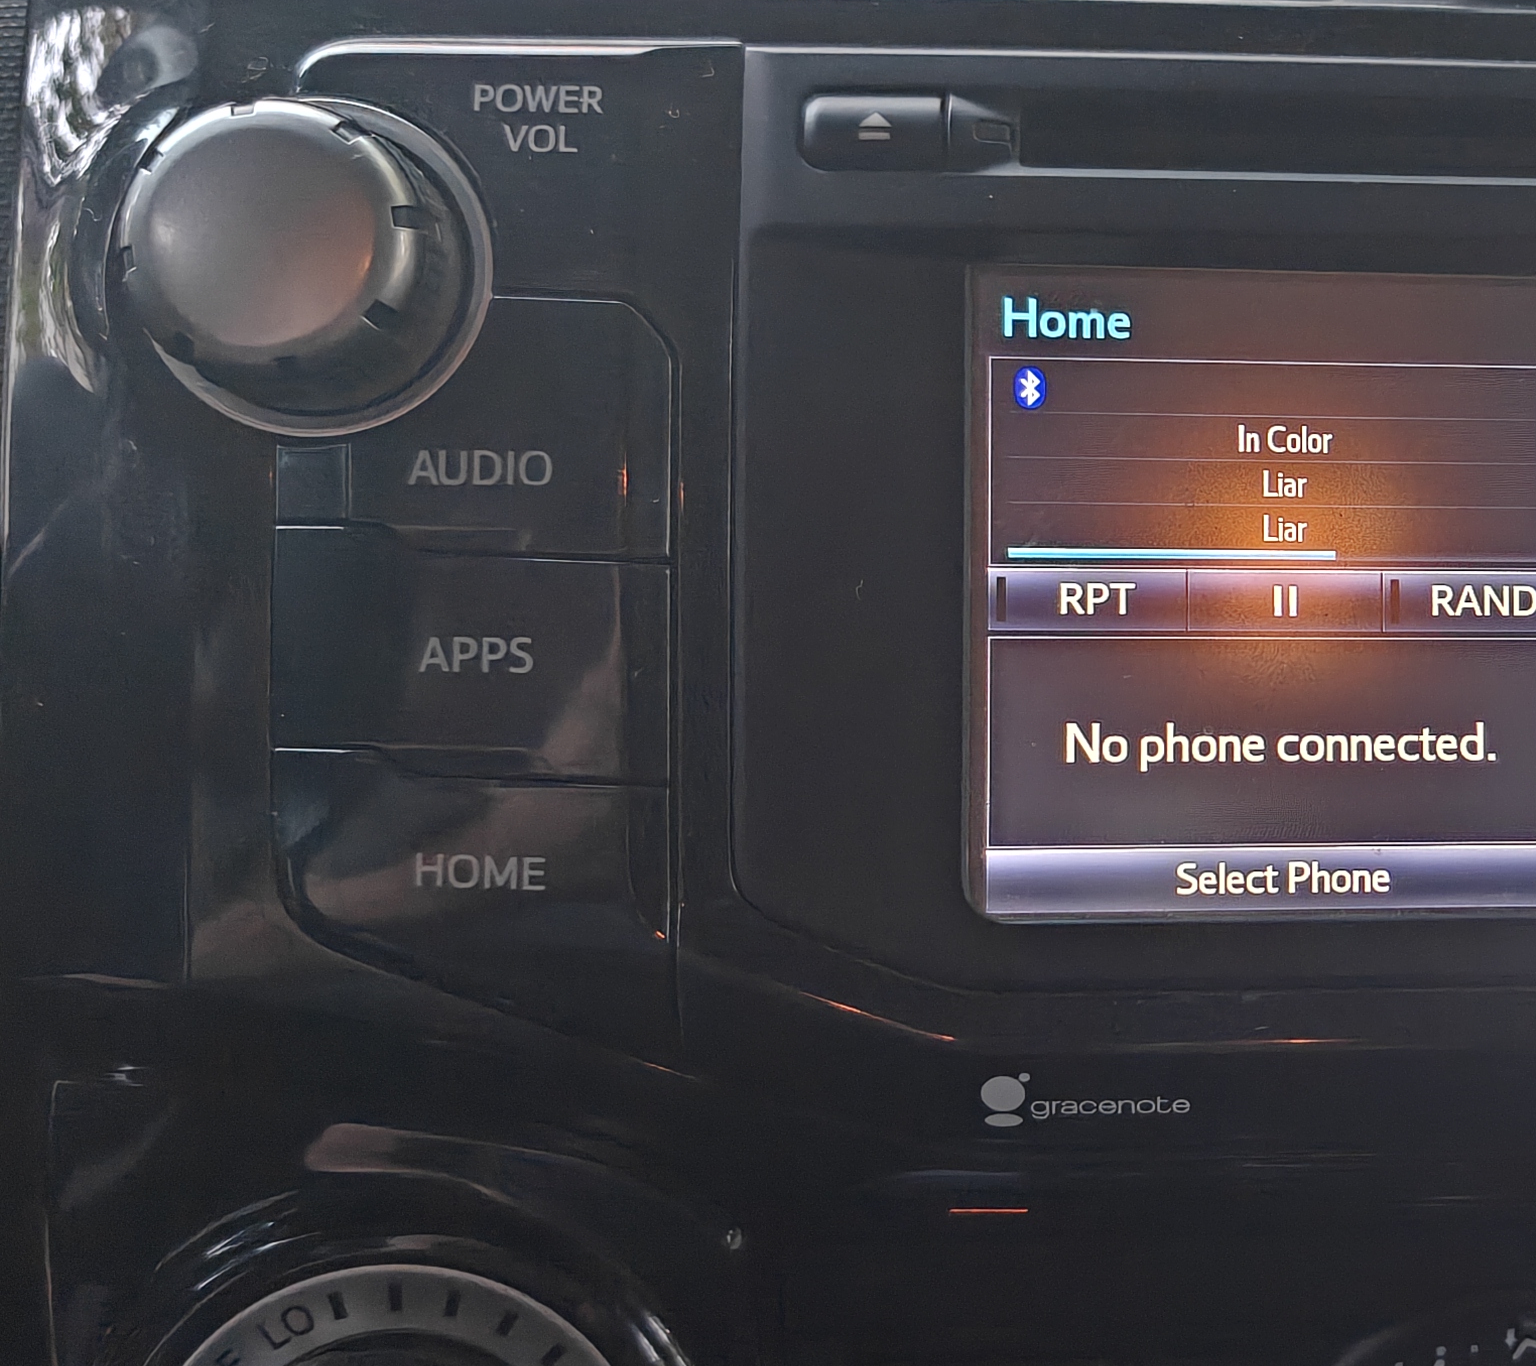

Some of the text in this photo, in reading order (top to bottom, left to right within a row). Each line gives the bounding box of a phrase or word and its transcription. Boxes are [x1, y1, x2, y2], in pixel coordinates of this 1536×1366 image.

[472, 82, 603, 115] POWER
[503, 122, 578, 154] VOL
[1001, 297, 1132, 340] Home
[1237, 425, 1334, 456] In Color
[407, 449, 553, 487] AUDIO
[1262, 469, 1308, 500] Liar
[1262, 513, 1308, 544] Liar
[1058, 582, 1136, 616] RPT
[418, 637, 534, 674] APPS
[1064, 722, 1498, 772] No phone connected.
[414, 853, 546, 892] HOME
[1175, 861, 1391, 896] Select Phone
[1030, 1095, 1191, 1119] gracenote
[256, 1304, 315, 1350] LO
